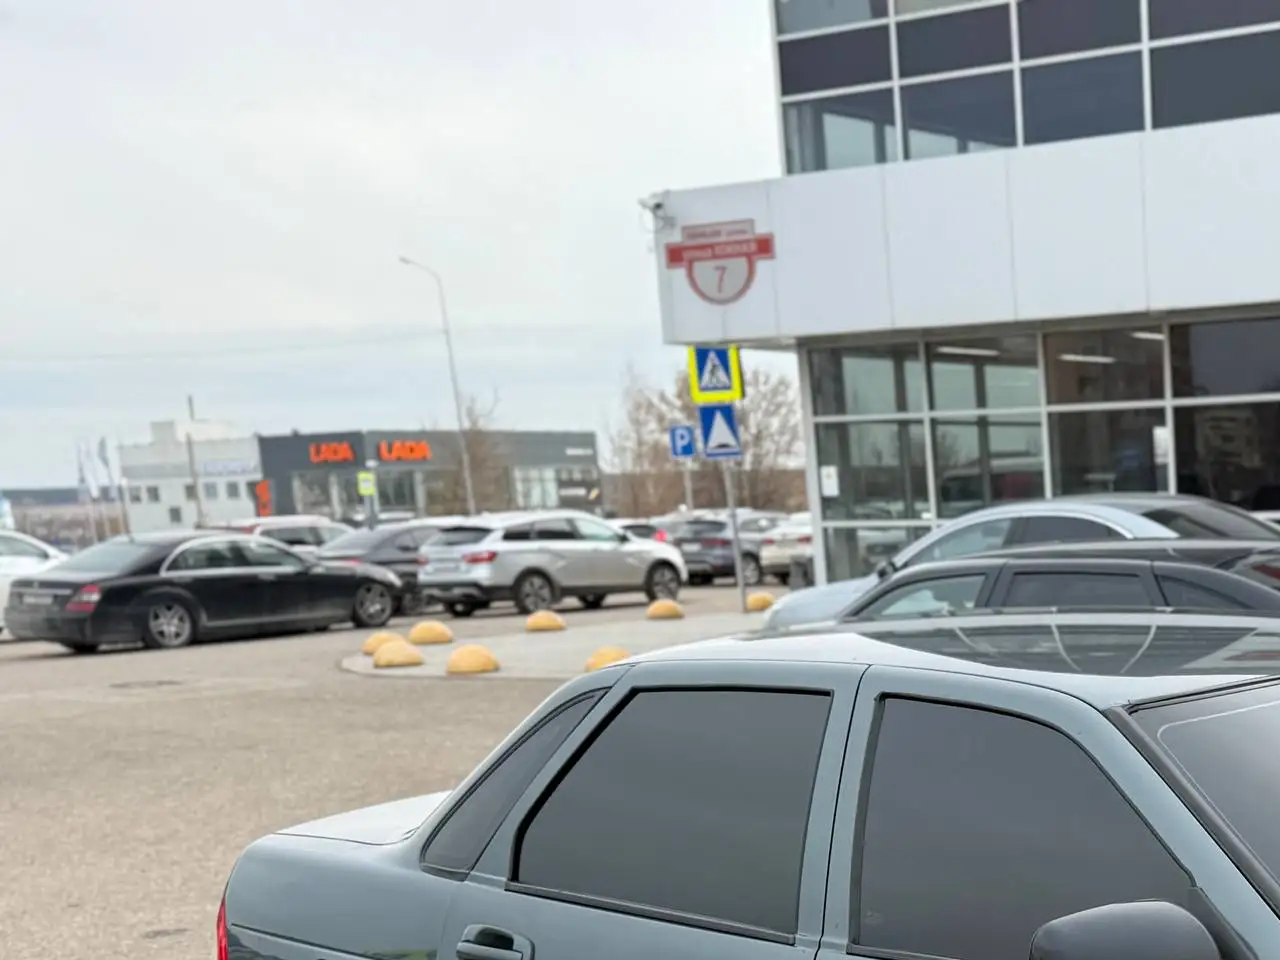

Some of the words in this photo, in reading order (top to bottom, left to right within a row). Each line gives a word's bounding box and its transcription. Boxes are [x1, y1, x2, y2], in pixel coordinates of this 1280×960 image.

[713, 265, 727, 293] 7
[379, 440, 432, 461] LADA
[674, 429, 690, 454] P
